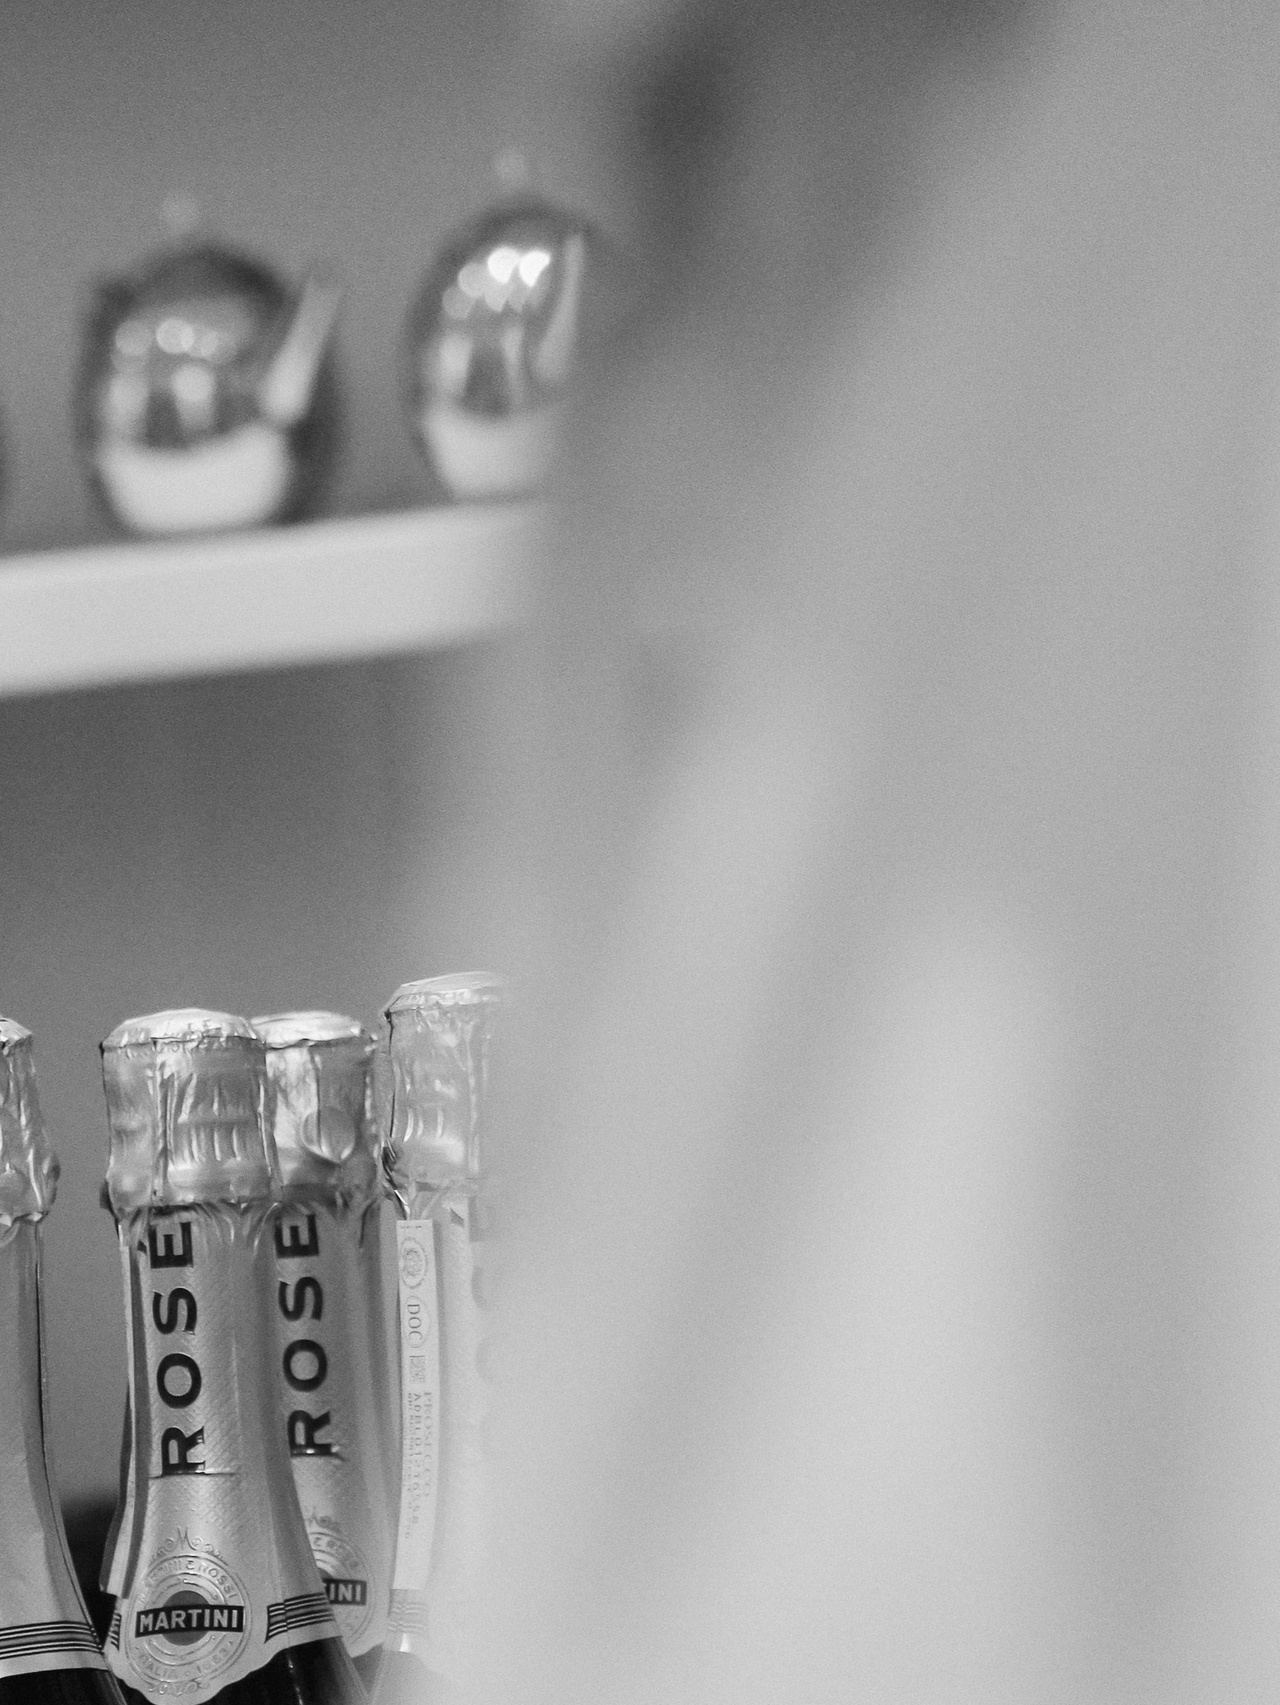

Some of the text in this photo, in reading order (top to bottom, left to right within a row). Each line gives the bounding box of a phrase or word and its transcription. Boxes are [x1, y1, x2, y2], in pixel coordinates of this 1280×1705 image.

[407, 1304, 422, 1342] DOC
[138, 1221, 205, 1476] ROSÉ
[139, 1608, 238, 1633] MARTINI
